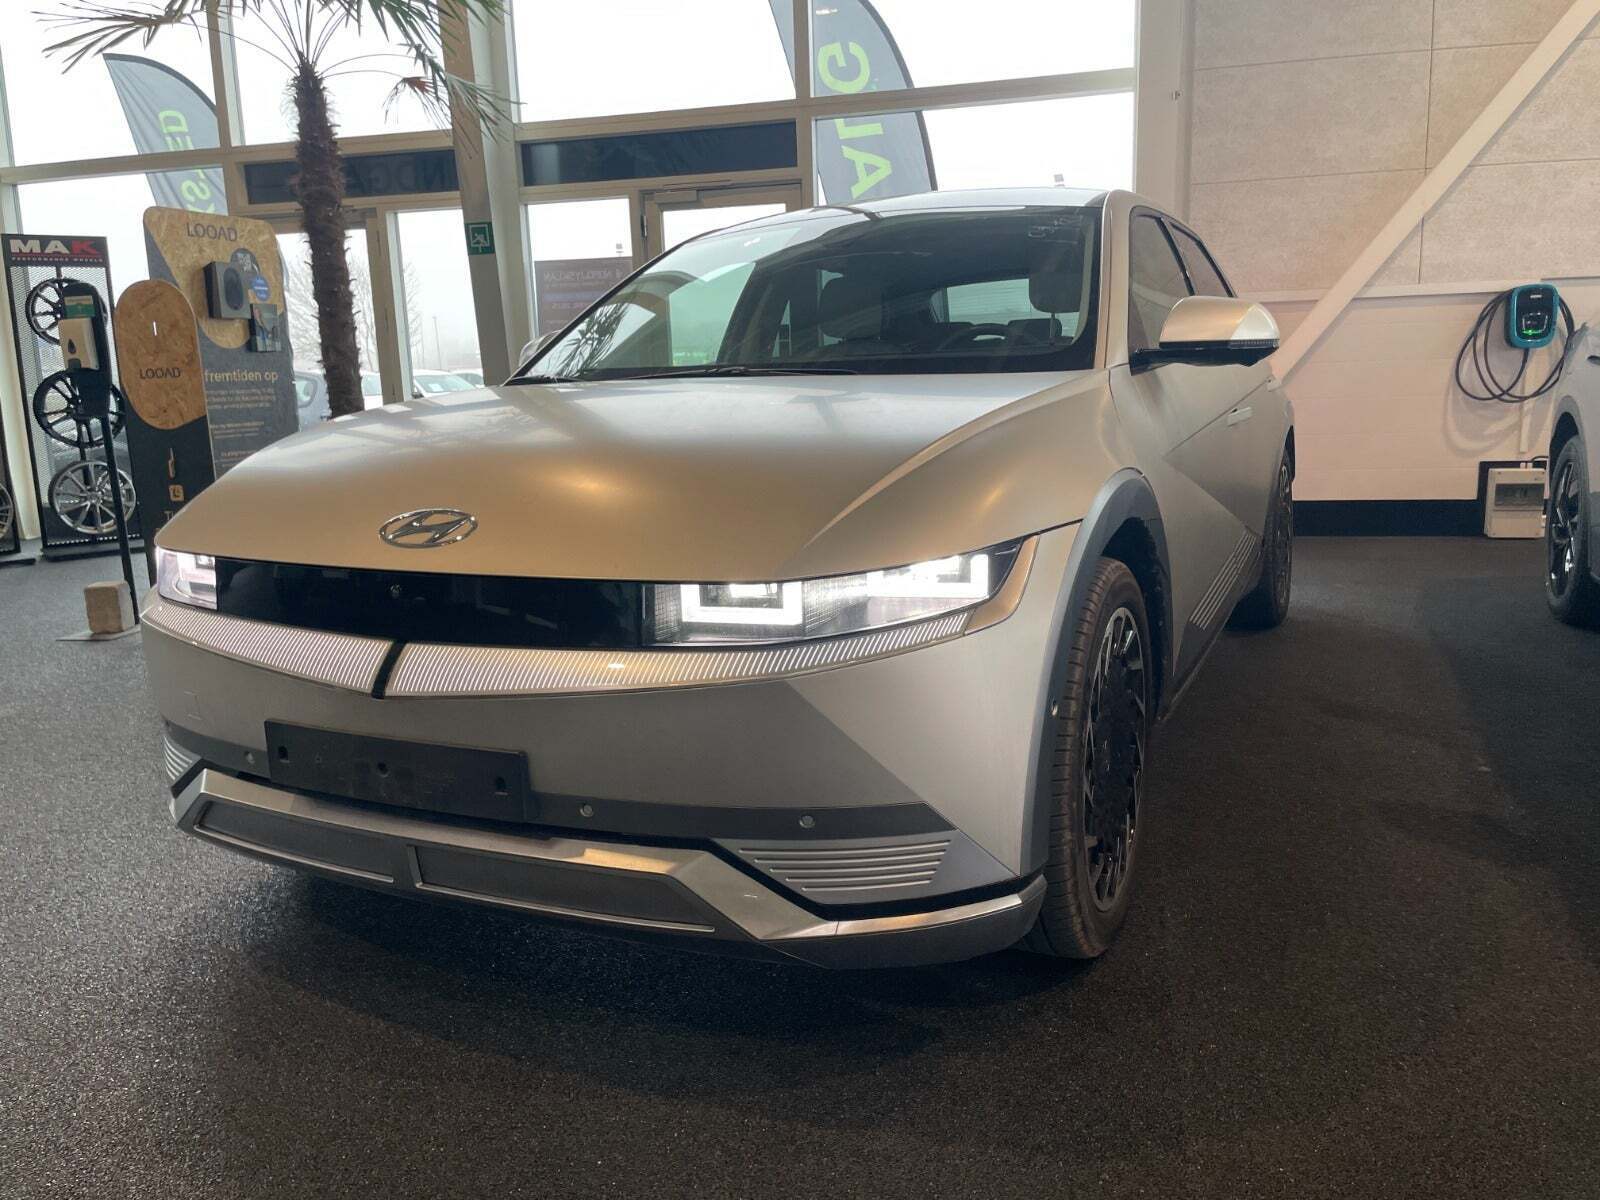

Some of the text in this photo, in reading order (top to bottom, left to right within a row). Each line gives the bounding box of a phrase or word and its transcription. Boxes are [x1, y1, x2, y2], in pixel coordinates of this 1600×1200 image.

[186, 222, 238, 242] LOOAD
[9, 239, 97, 254] MAK
[139, 367, 181, 380] LOOAD
[204, 368, 279, 383] fremtiden op
